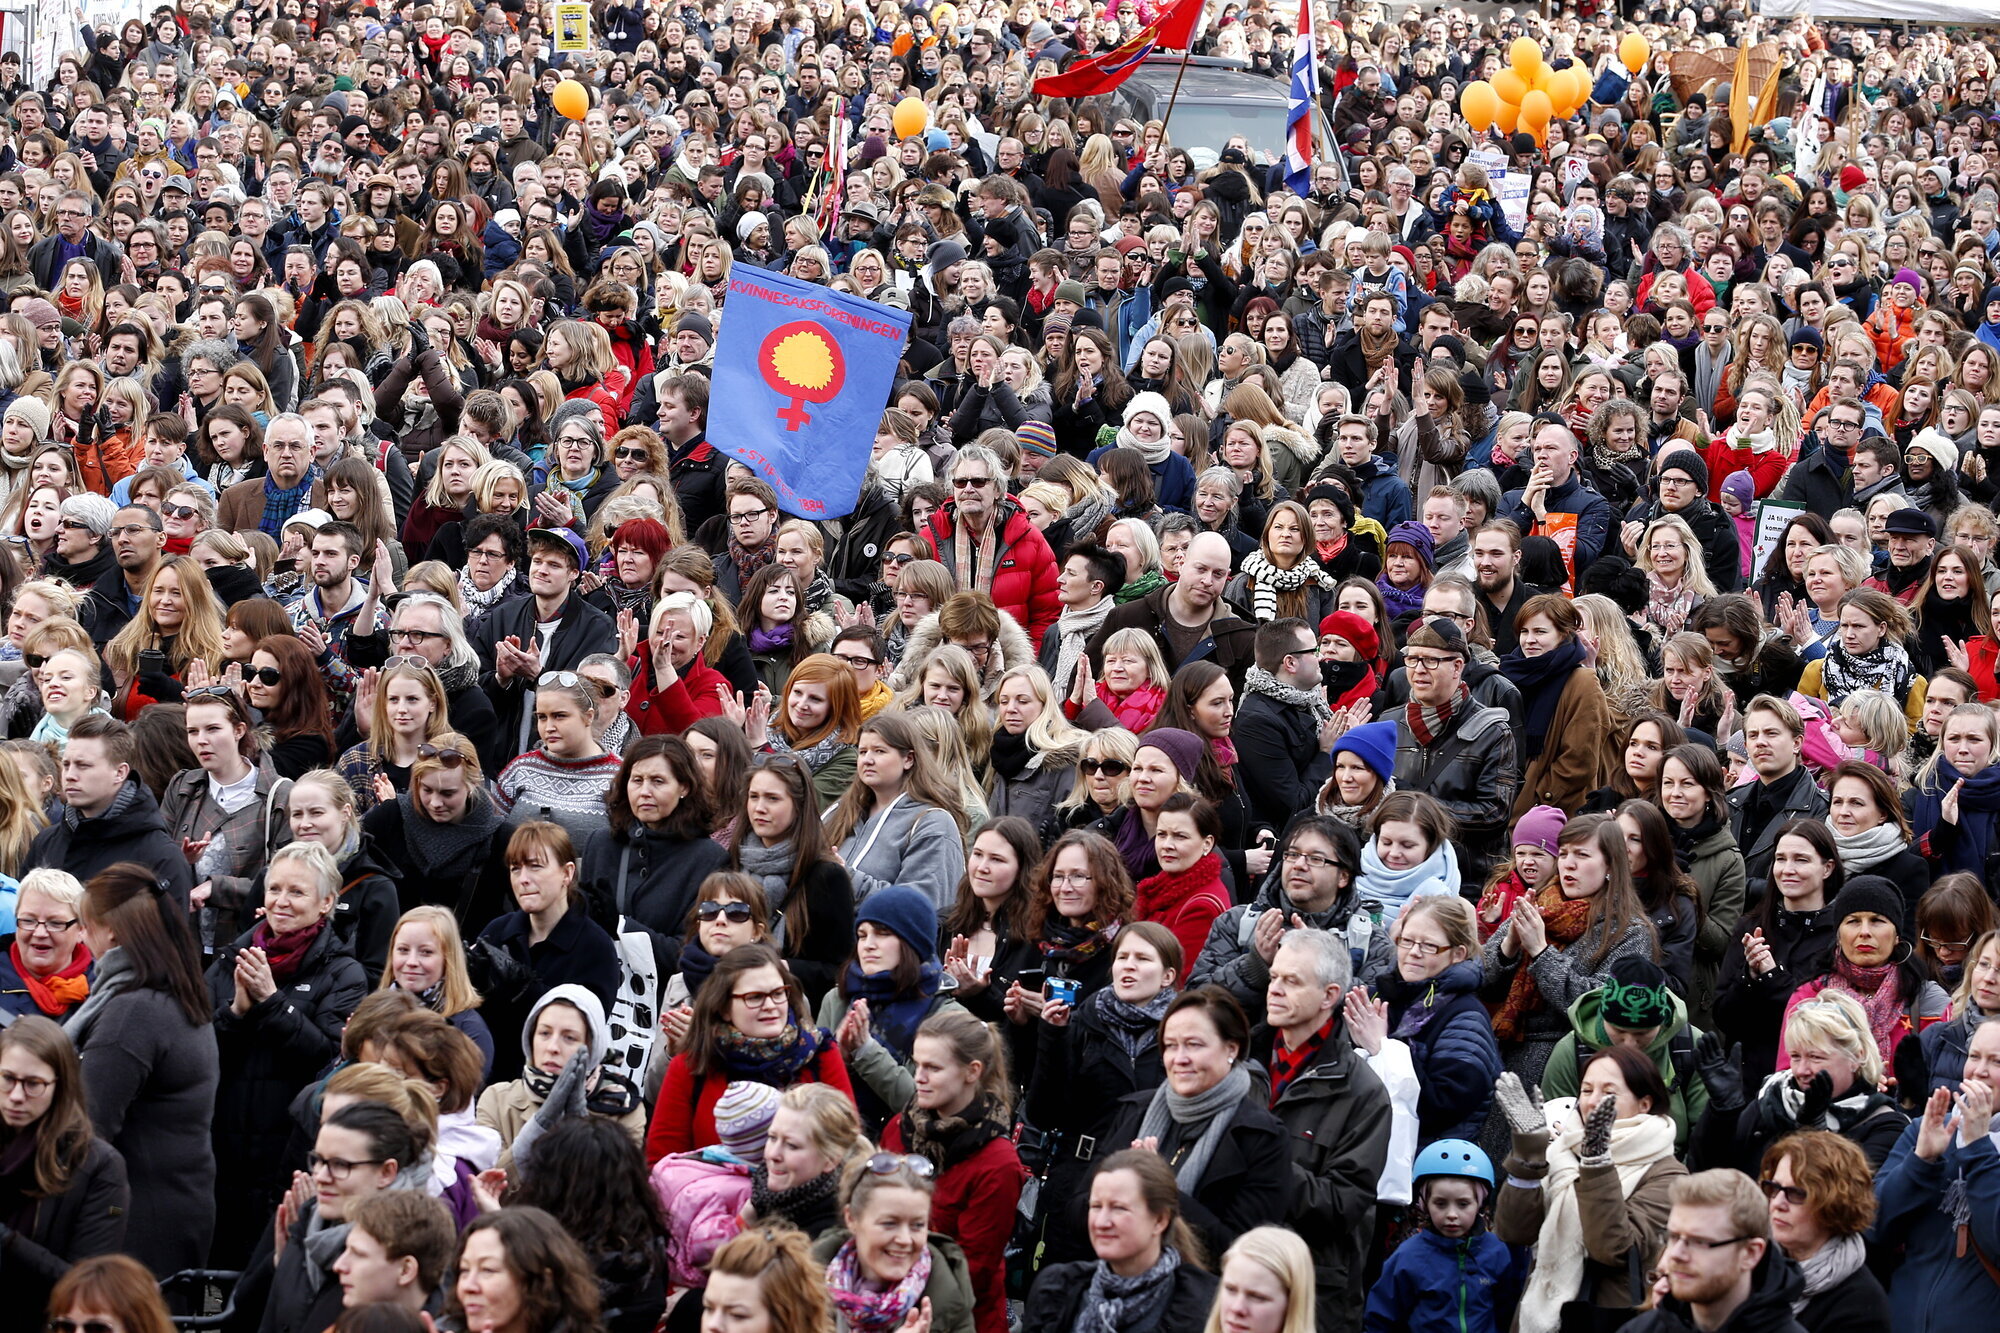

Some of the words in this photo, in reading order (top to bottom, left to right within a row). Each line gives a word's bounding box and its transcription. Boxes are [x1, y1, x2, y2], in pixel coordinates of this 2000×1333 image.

[730, 279, 902, 341] KVINNESAKSFORENINGEN
[746, 449, 795, 500] STIFTET
[797, 498, 826, 514] 1884
